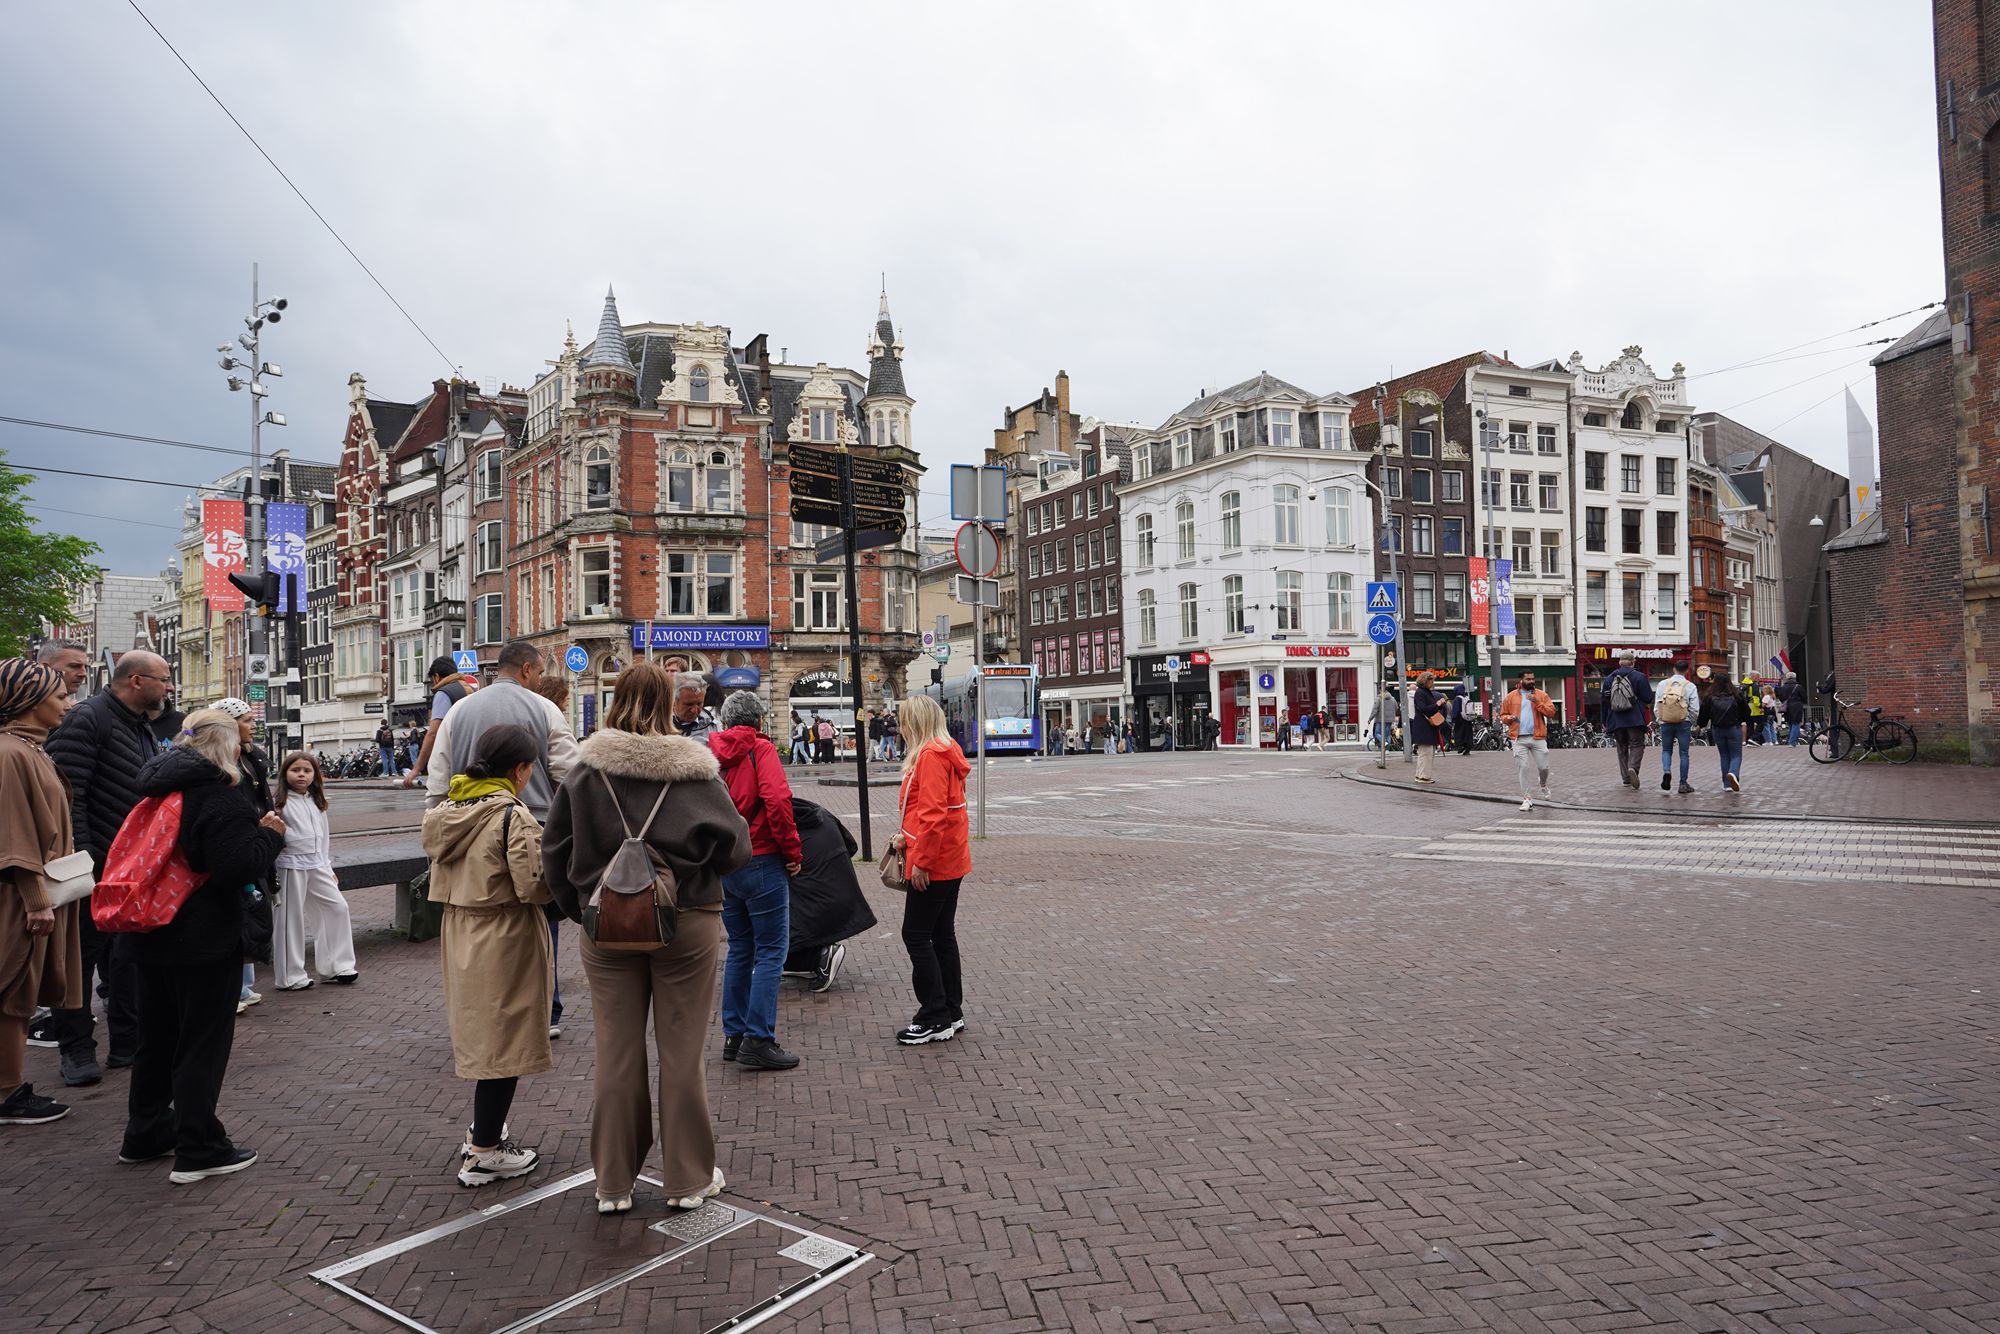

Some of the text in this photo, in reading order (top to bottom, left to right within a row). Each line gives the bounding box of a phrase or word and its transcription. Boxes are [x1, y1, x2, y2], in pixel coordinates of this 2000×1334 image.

[639, 630, 762, 642] DAMOND FACTORY
[1611, 648, 1674, 659] MDonald's
[1152, 661, 1191, 672] BODULT
[801, 673, 819, 685] FISH
[828, 671, 850, 684] FRS
